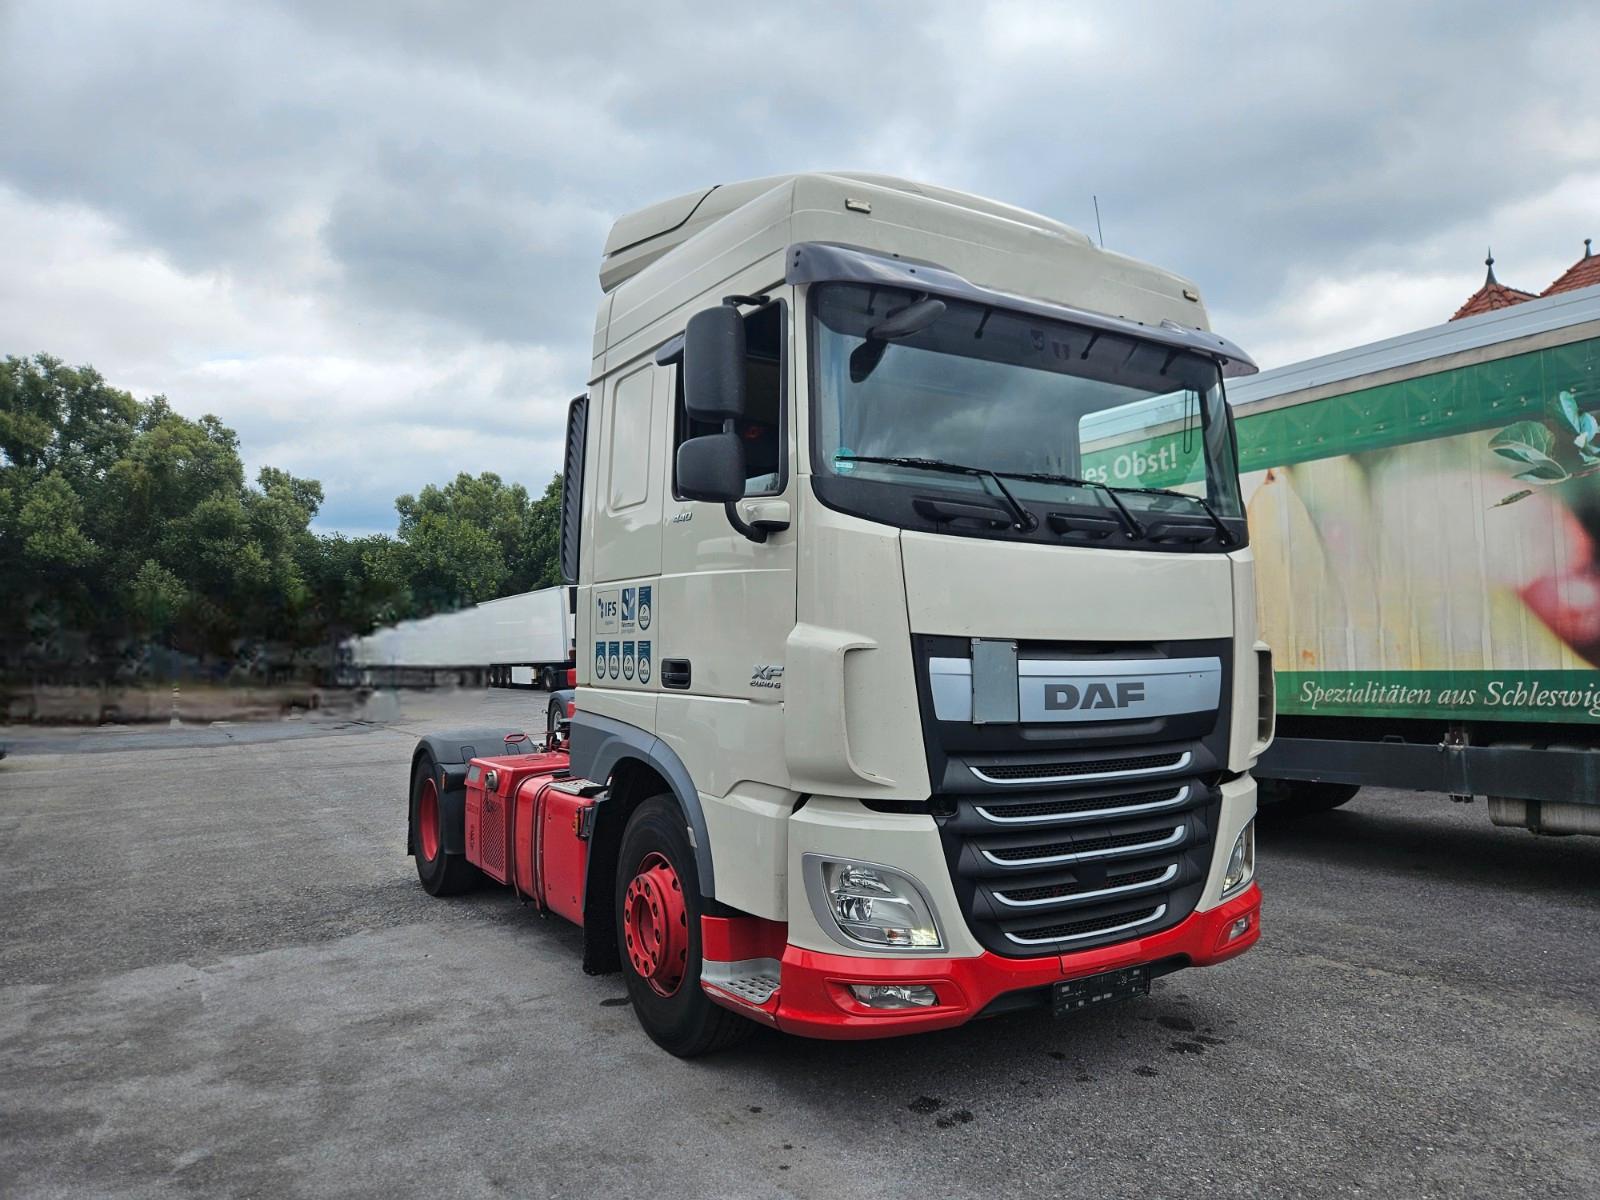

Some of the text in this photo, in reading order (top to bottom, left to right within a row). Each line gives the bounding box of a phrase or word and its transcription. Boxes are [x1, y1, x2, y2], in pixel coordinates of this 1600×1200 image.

[1113, 443, 1177, 479] Obst!
[605, 601, 617, 617] IFS
[751, 664, 785, 681] XF
[1044, 682, 1145, 711] DAF
[1300, 680, 1432, 710] Spezialitäten
[1437, 688, 1477, 706] aus
